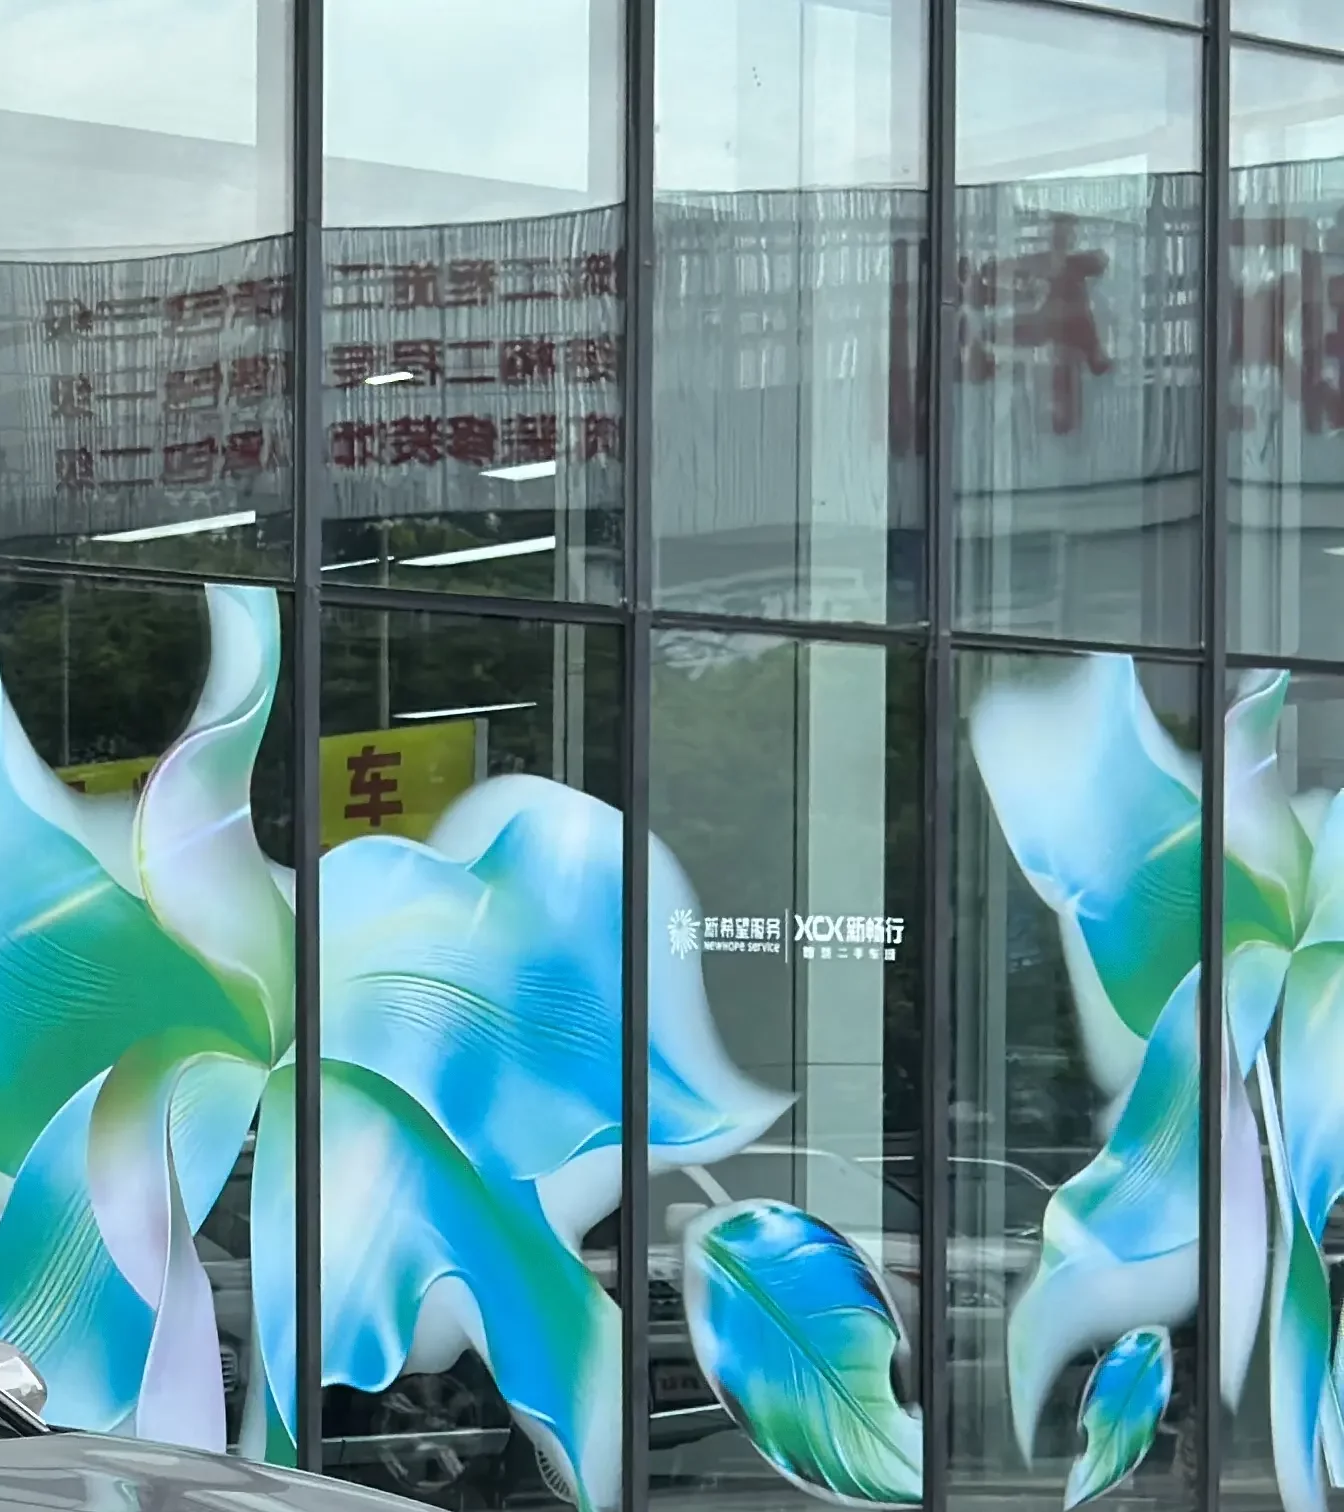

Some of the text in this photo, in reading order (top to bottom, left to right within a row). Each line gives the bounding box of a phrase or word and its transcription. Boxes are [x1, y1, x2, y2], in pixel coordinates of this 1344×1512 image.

[344, 745, 404, 827] 车
[703, 916, 781, 940] 新希望服务
